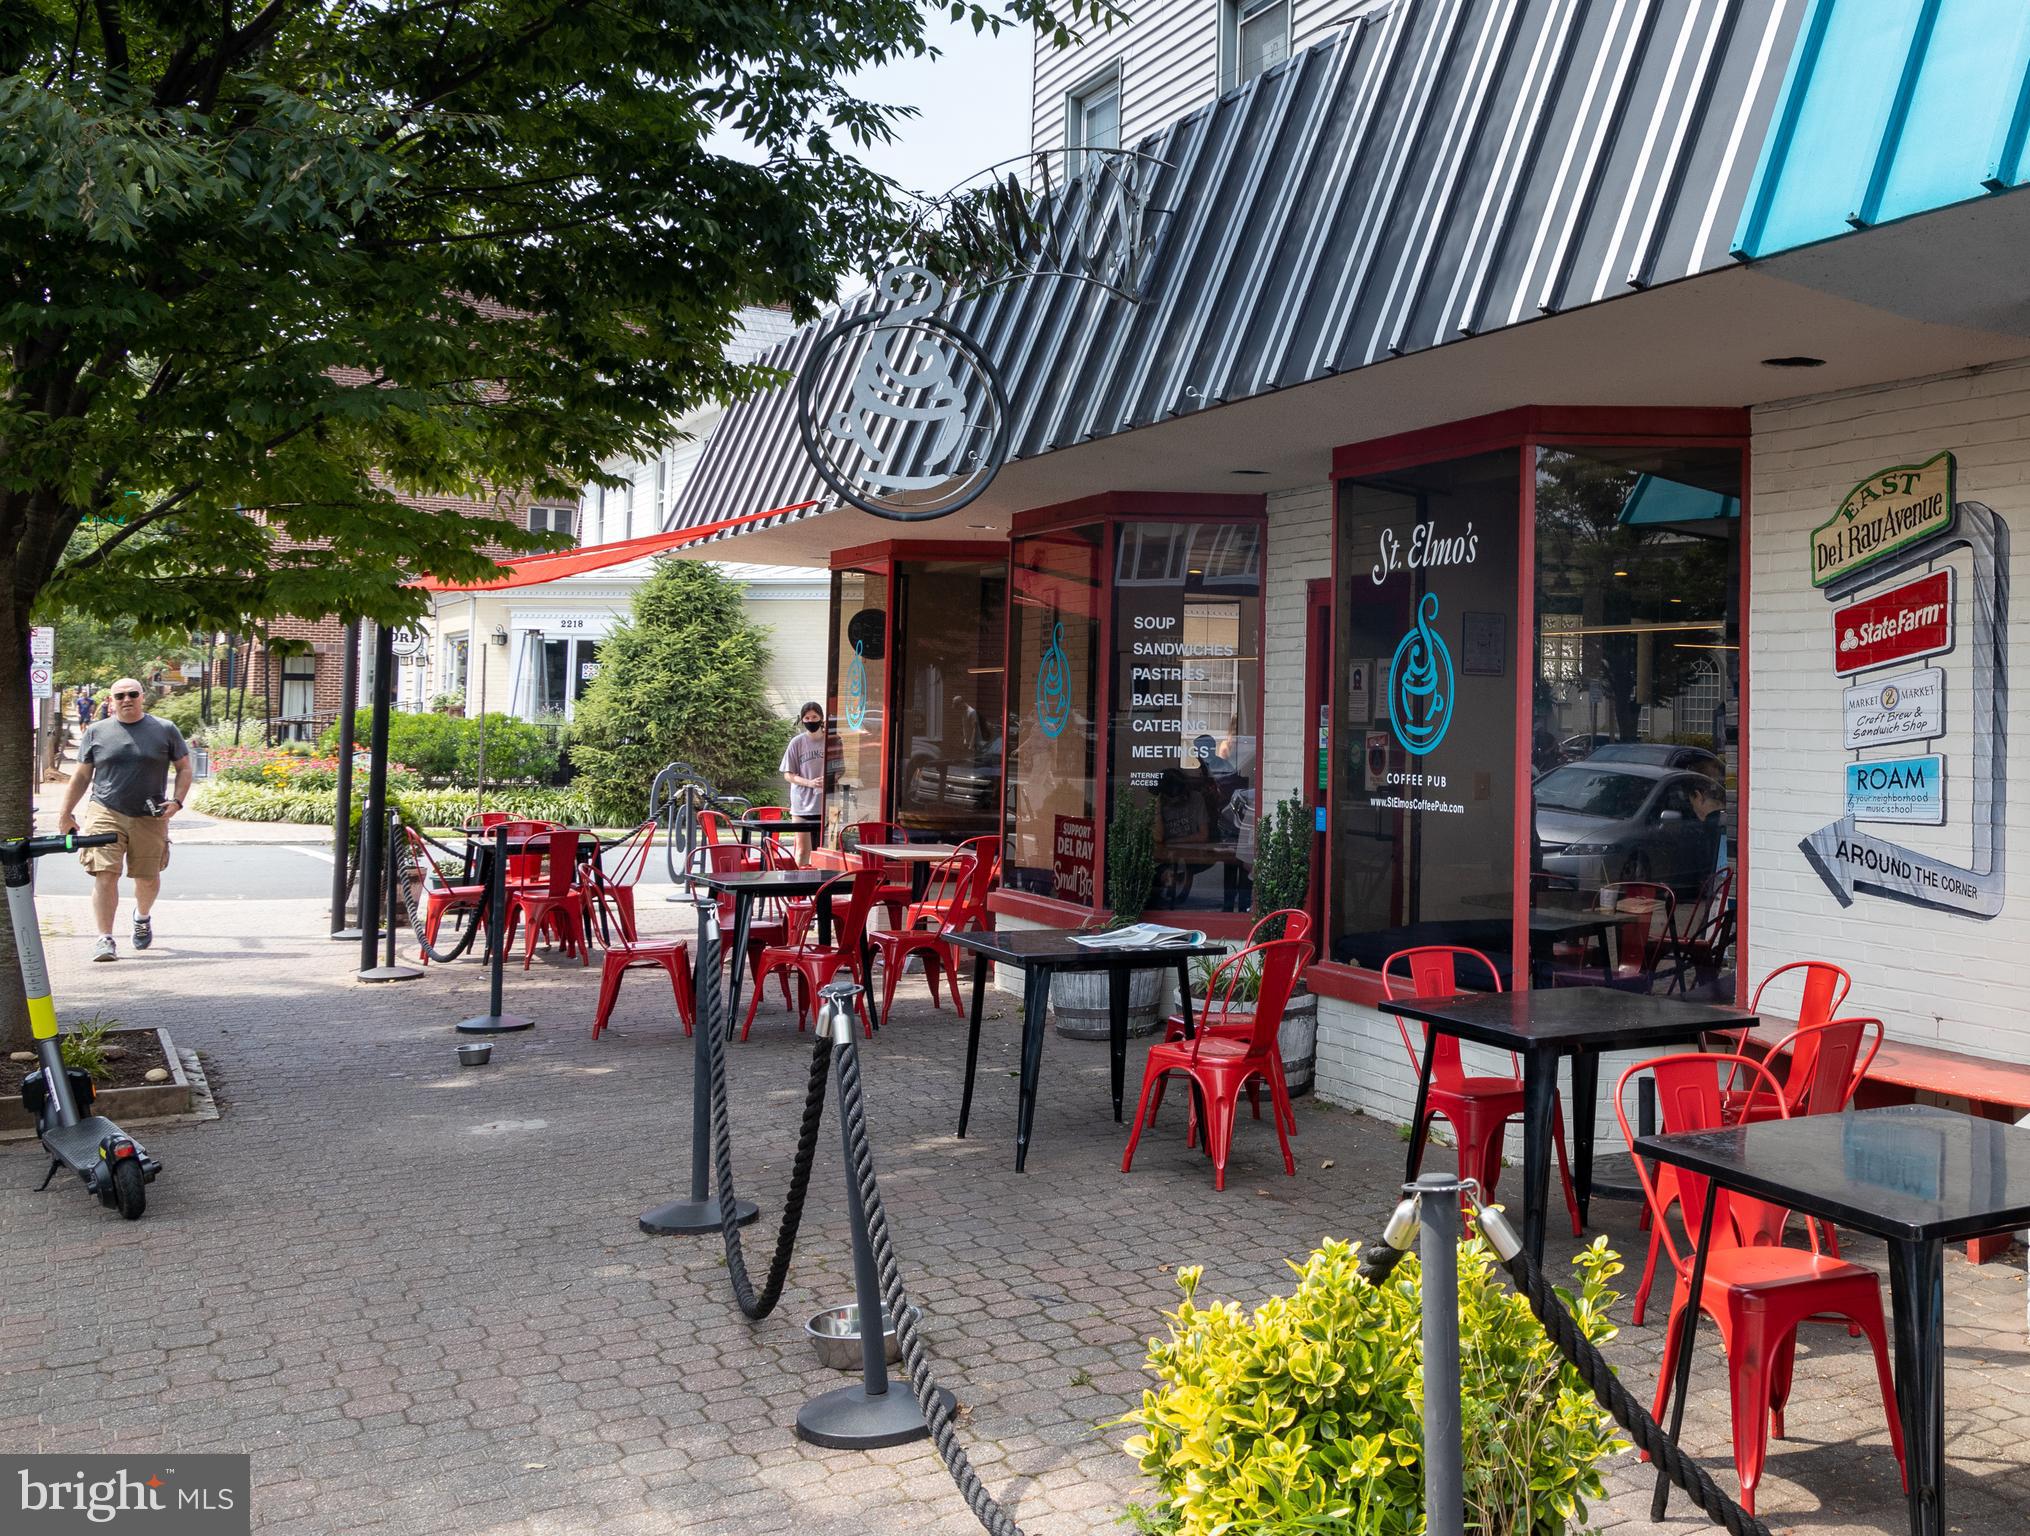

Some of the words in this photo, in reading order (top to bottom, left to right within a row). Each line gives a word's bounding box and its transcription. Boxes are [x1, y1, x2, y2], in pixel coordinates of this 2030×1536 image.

[1842, 473, 1921, 523] EAST
[1817, 530, 1844, 573] Del
[1847, 517, 1884, 559] Ray
[1881, 492, 1943, 542] Avenue
[1372, 528, 1402, 586] St.
[1407, 521, 1479, 569] Elmo's
[560, 619, 584, 628] 2218
[1133, 616, 1176, 630] SOUP
[1133, 643, 1234, 656] SANDWICHES
[1132, 667, 1205, 681] PASTRIES
[1132, 693, 1193, 706] BAGELS
[1848, 695, 1880, 710] MARKET
[1885, 688, 1896, 706] 2
[1900, 684, 1936, 701] MARKET
[1132, 719, 1208, 732] CATERING
[1856, 713, 1886, 727] Craft
[1886, 710, 1913, 723] Brew
[1914, 706, 1923, 718] &
[1852, 723, 1900, 740] Sandwich
[1901, 719, 1928, 733] Shop
[1131, 745, 1210, 759] MEETINGS
[1130, 772, 1164, 780] INTERNET
[1386, 773, 1423, 786] COFFEE
[1427, 775, 1447, 788] PUB
[1857, 765, 1925, 791] ROAM
[1370, 796, 1465, 814] www.StElmosCoffeePub.com
[1855, 795, 1872, 804] your
[1872, 791, 1929, 805] neighborhood
[1865, 805, 1886, 813] music
[1886, 803, 1913, 813] school
[1062, 822, 1092, 840] SUPPORT
[1057, 836, 1075, 857] DEL
[1075, 839, 1094, 861] RAY
[1054, 860, 1078, 893] Small
[1835, 840, 1912, 880] AROUND
[1914, 866, 1939, 888] THE
[1941, 875, 1978, 900] CORNER
